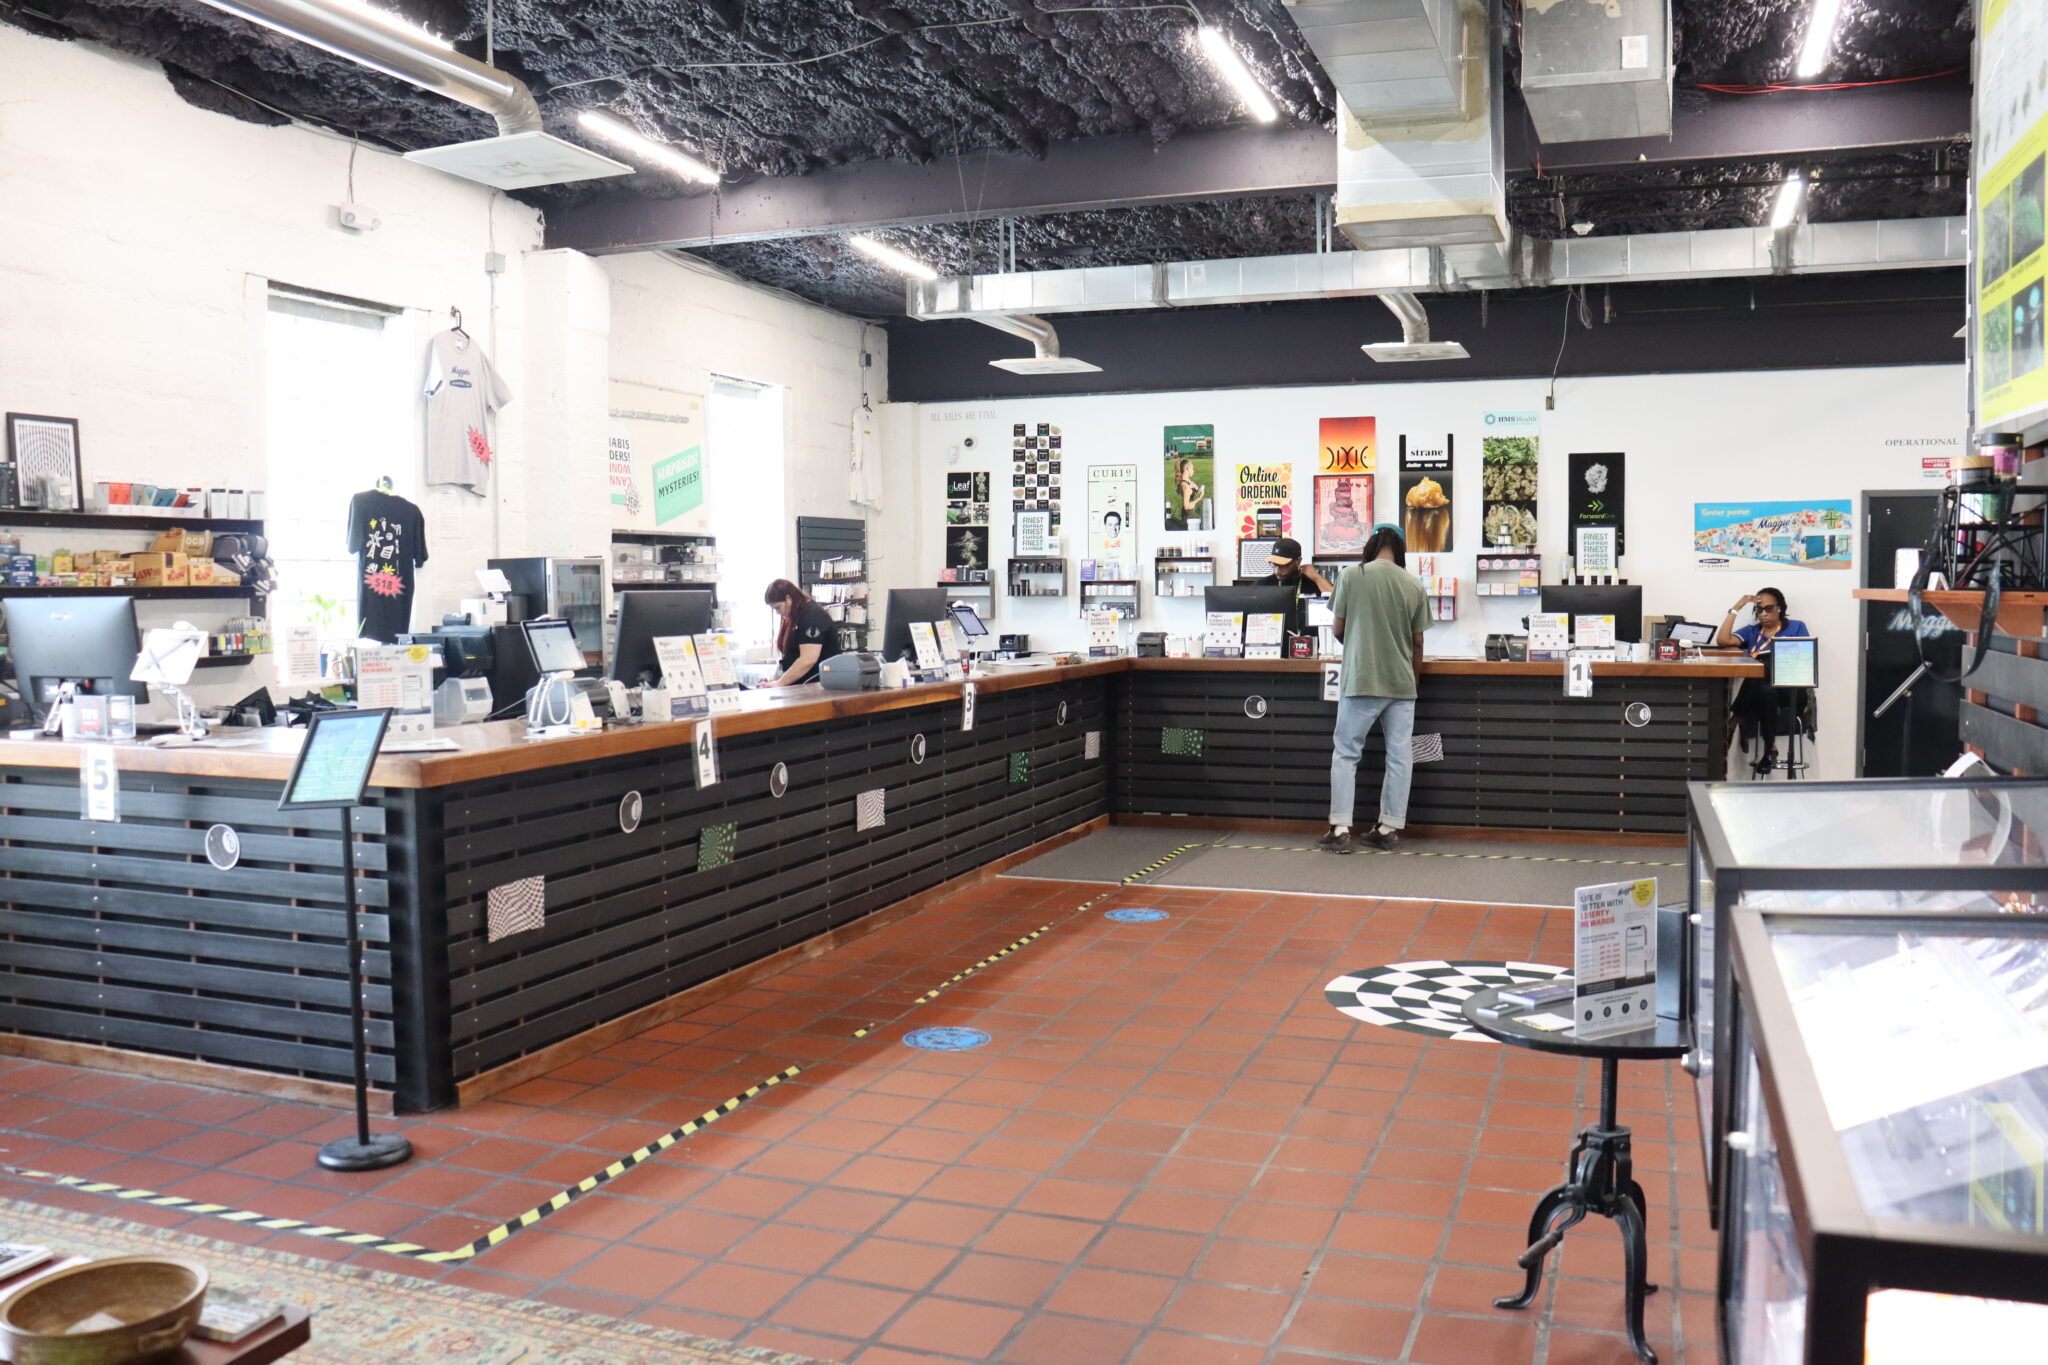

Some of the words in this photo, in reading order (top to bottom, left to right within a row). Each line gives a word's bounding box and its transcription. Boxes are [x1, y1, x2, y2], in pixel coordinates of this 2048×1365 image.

[609, 437, 630, 449] ABIS
[1885, 438, 1960, 447] OPERATIONAL
[1093, 469, 1132, 478] CURIO
[1240, 465, 1279, 484] Online
[658, 470, 700, 499] MYSTERIES!
[1241, 485, 1287, 499] ORDERING
[185, 536, 205, 545] OCB
[1326, 670, 1339, 686] 2
[1572, 663, 1582, 681] 1
[966, 691, 973, 713] 3
[699, 732, 711, 760] 4
[93, 759, 109, 791] 5
